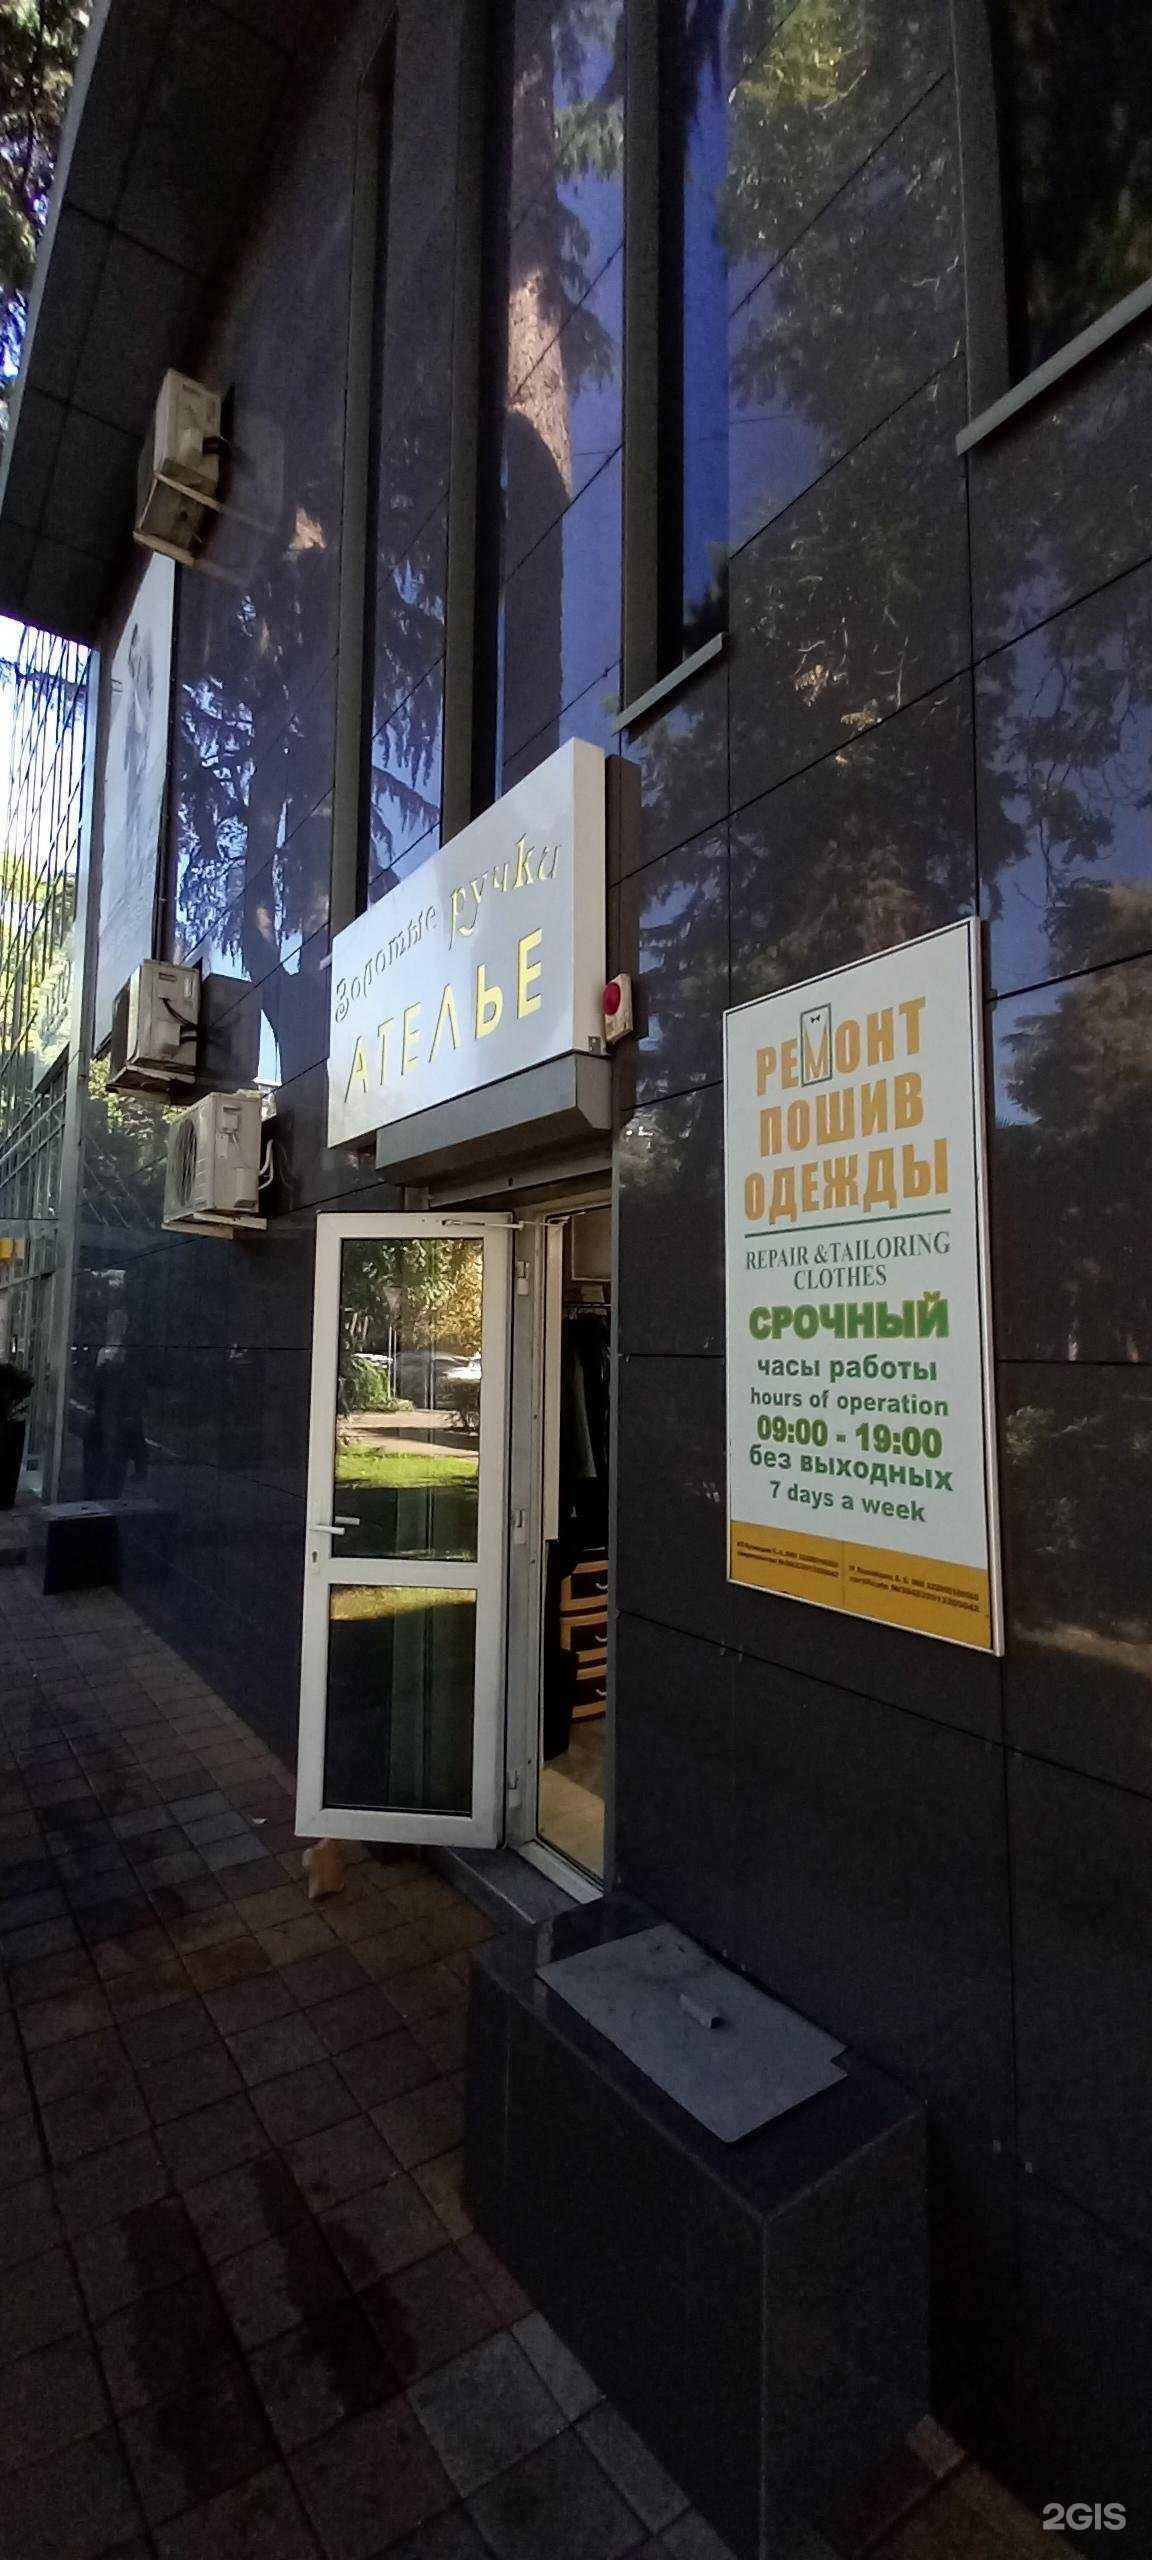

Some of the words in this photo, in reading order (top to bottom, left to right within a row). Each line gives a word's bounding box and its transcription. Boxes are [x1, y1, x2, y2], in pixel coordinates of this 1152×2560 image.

[344, 927, 544, 1103] АТЕЛЬЕ
[756, 996, 927, 1097] РЕМОНТ
[759, 1071, 925, 1158] ПОШИВ
[743, 1138, 949, 1226] ОДЕЖДЫ
[746, 1245, 808, 1270] REPAIR
[794, 1264, 887, 1290] CLOTHES
[749, 1290, 950, 1340] СРОЧНЫЙ
[757, 1358, 820, 1377] часы
[829, 1353, 937, 1383] работы
[750, 1387, 802, 1407] hours
[809, 1389, 830, 1408] of
[837, 1393, 949, 1416] operation
[757, 1414, 828, 1447] 09:00
[855, 1422, 943, 1459] 19:00
[750, 1444, 792, 1470] без
[800, 1453, 953, 1491] выходных
[770, 1480, 781, 1499] 7
[787, 1483, 834, 1510] days
[841, 1494, 854, 1511] a
[862, 1497, 926, 1522] week
